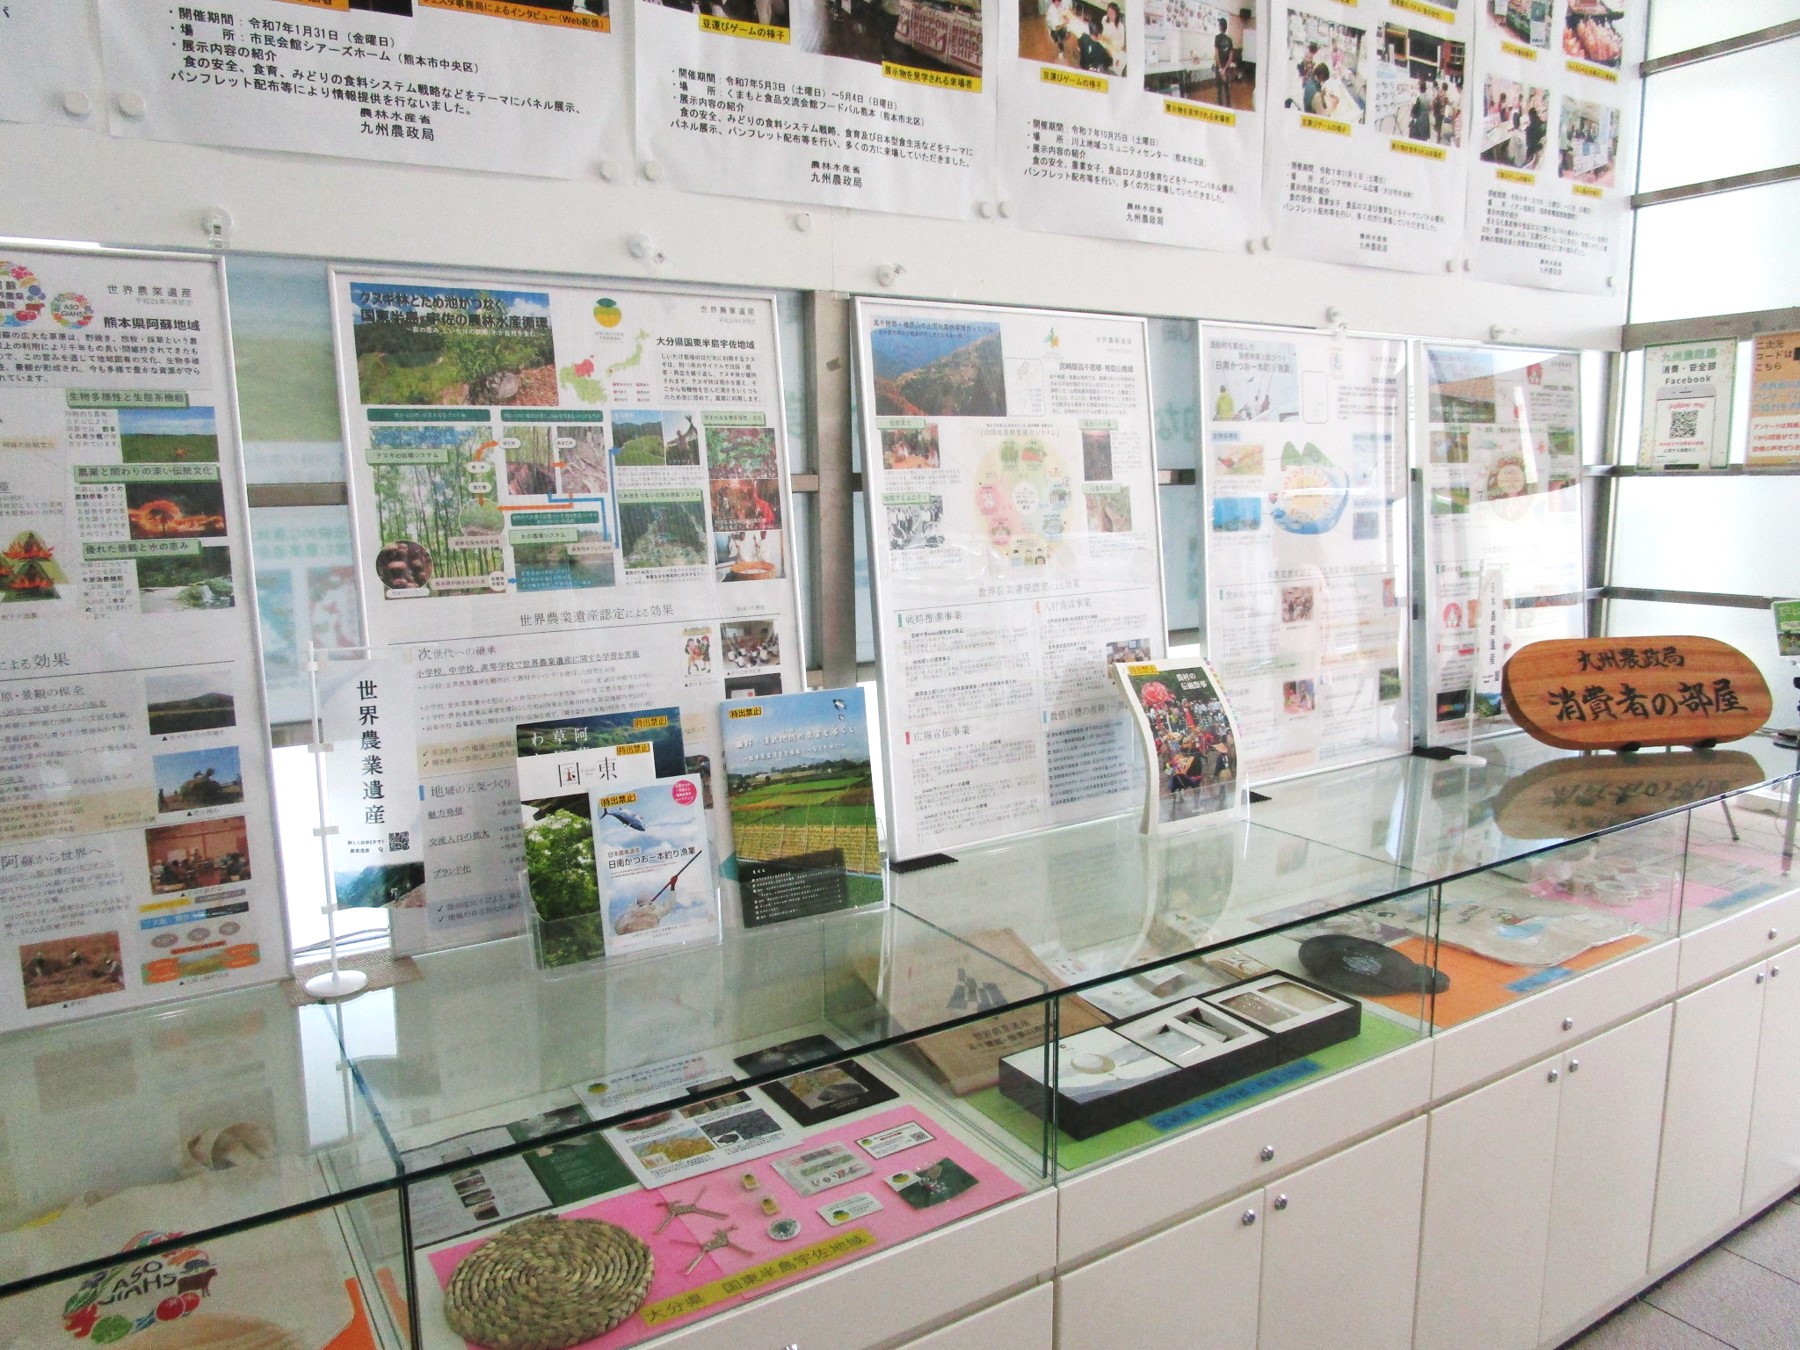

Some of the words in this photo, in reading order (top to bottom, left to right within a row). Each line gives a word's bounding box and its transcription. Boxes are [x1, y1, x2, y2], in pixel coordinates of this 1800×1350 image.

[702, 17, 785, 41] 豆運びゲームの様子
[360, 108, 432, 125] 農林水産省
[360, 121, 435, 141] 九州農政局
[811, 159, 861, 175] 農林水産省
[810, 172, 863, 189] 九州農政局
[1126, 213, 1164, 226] 九州農政局
[107, 284, 192, 298] 世界農業遺産
[360, 290, 506, 312] クヌギ林とため池がつなぐ
[104, 317, 200, 332] 熊本県阿蘇地域
[656, 337, 756, 350] 大分県国東半島宇佐地域
[1756, 340, 1785, 350] 二次元
[1756, 350, 1793, 360] コードは
[1661, 361, 1717, 374] 消費・安全部
[1755, 362, 1783, 372] こちら
[1664, 375, 1712, 386] Facebook
[520, 604, 674, 627] 世界農業遺産認定による効果
[418, 644, 497, 661] 次世代への継承
[1577, 645, 1685, 671] 九州農政局
[1547, 677, 1749, 722] 消費者の部屋
[357, 679, 385, 825] 世界農業遺産
[430, 779, 511, 797] 地域の元気づくり
[608, 846, 696, 870] 日南かつお一本釣り漁業
[433, 865, 472, 879] ブランド化
[113, 1261, 164, 1293] ASO
[646, 1292, 706, 1322] 大分県
[721, 1233, 866, 1294] 国東半島宇佐地域
